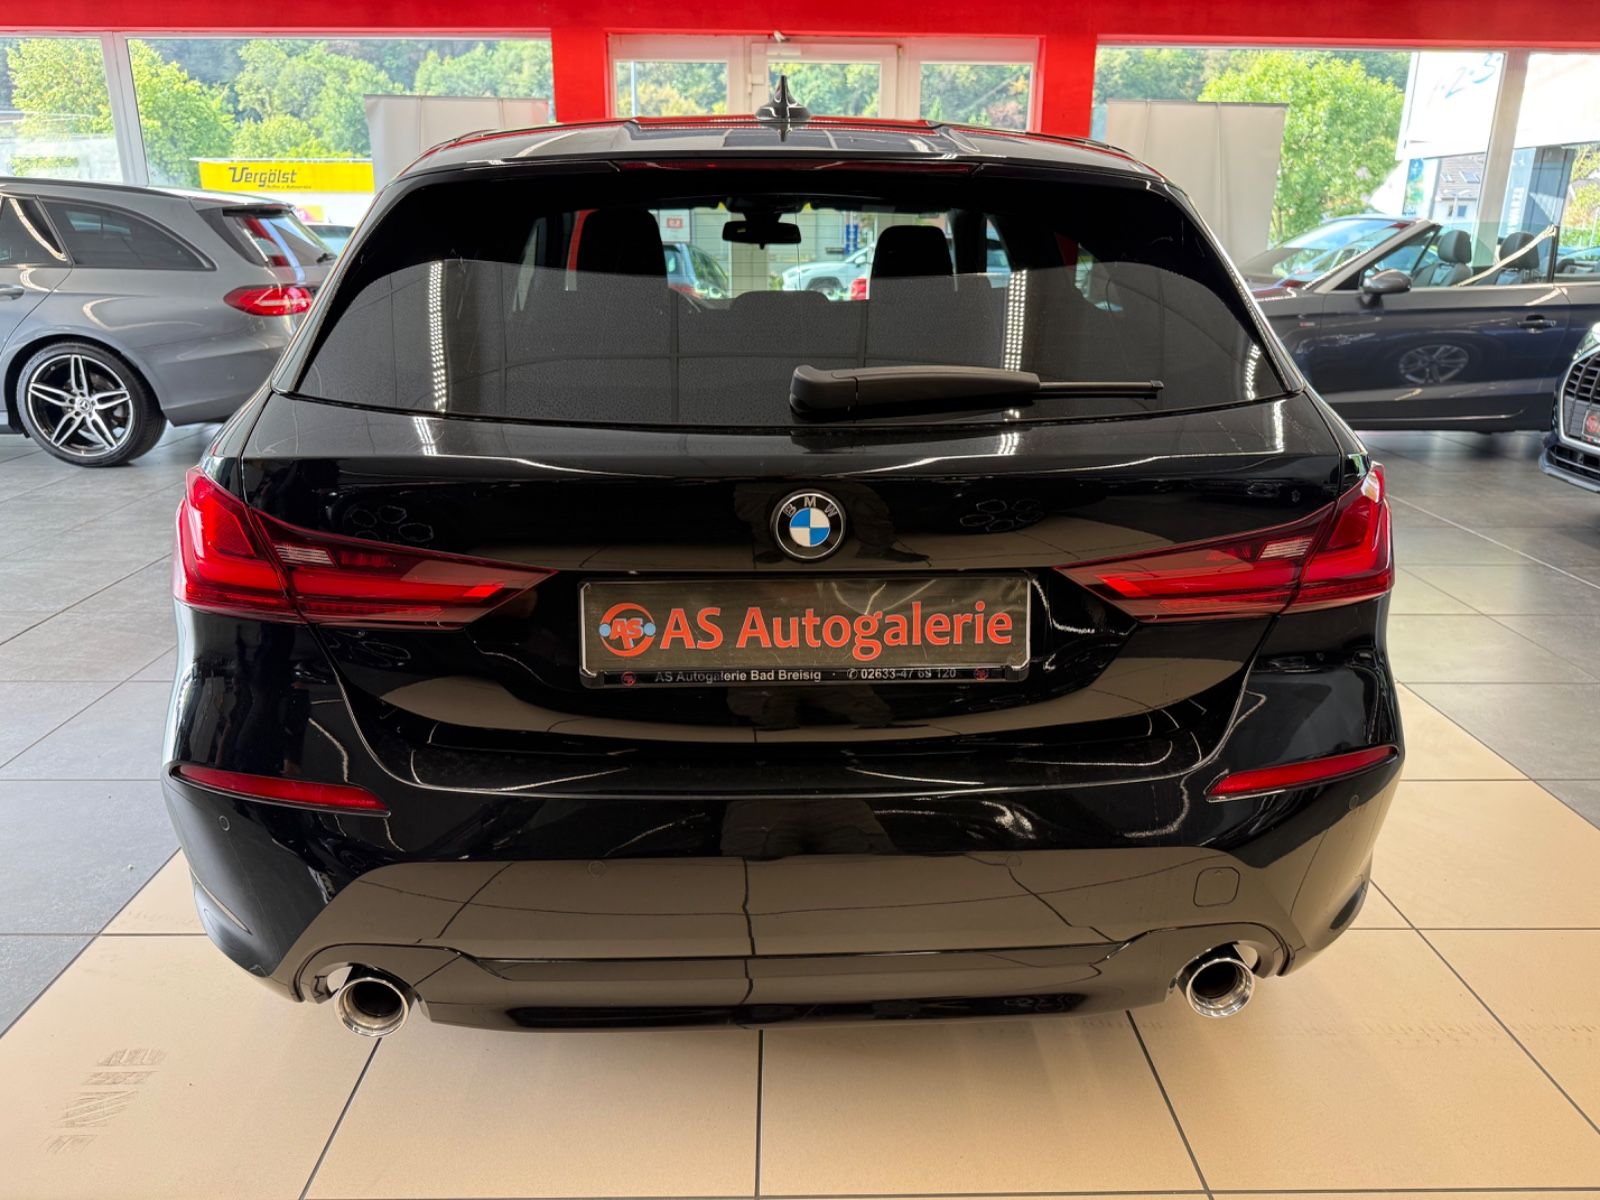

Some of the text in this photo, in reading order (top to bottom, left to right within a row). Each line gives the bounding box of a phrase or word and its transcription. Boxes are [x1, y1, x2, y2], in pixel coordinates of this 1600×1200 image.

[228, 167, 297, 187] Vergölst
[783, 496, 837, 517] BMW
[660, 600, 1013, 661] AS Autogalerie
[655, 671, 673, 682] AS
[676, 670, 747, 684] Autogalerie
[750, 669, 775, 681] Bad
[778, 669, 821, 682] Breisig
[936, 667, 957, 679] 120
